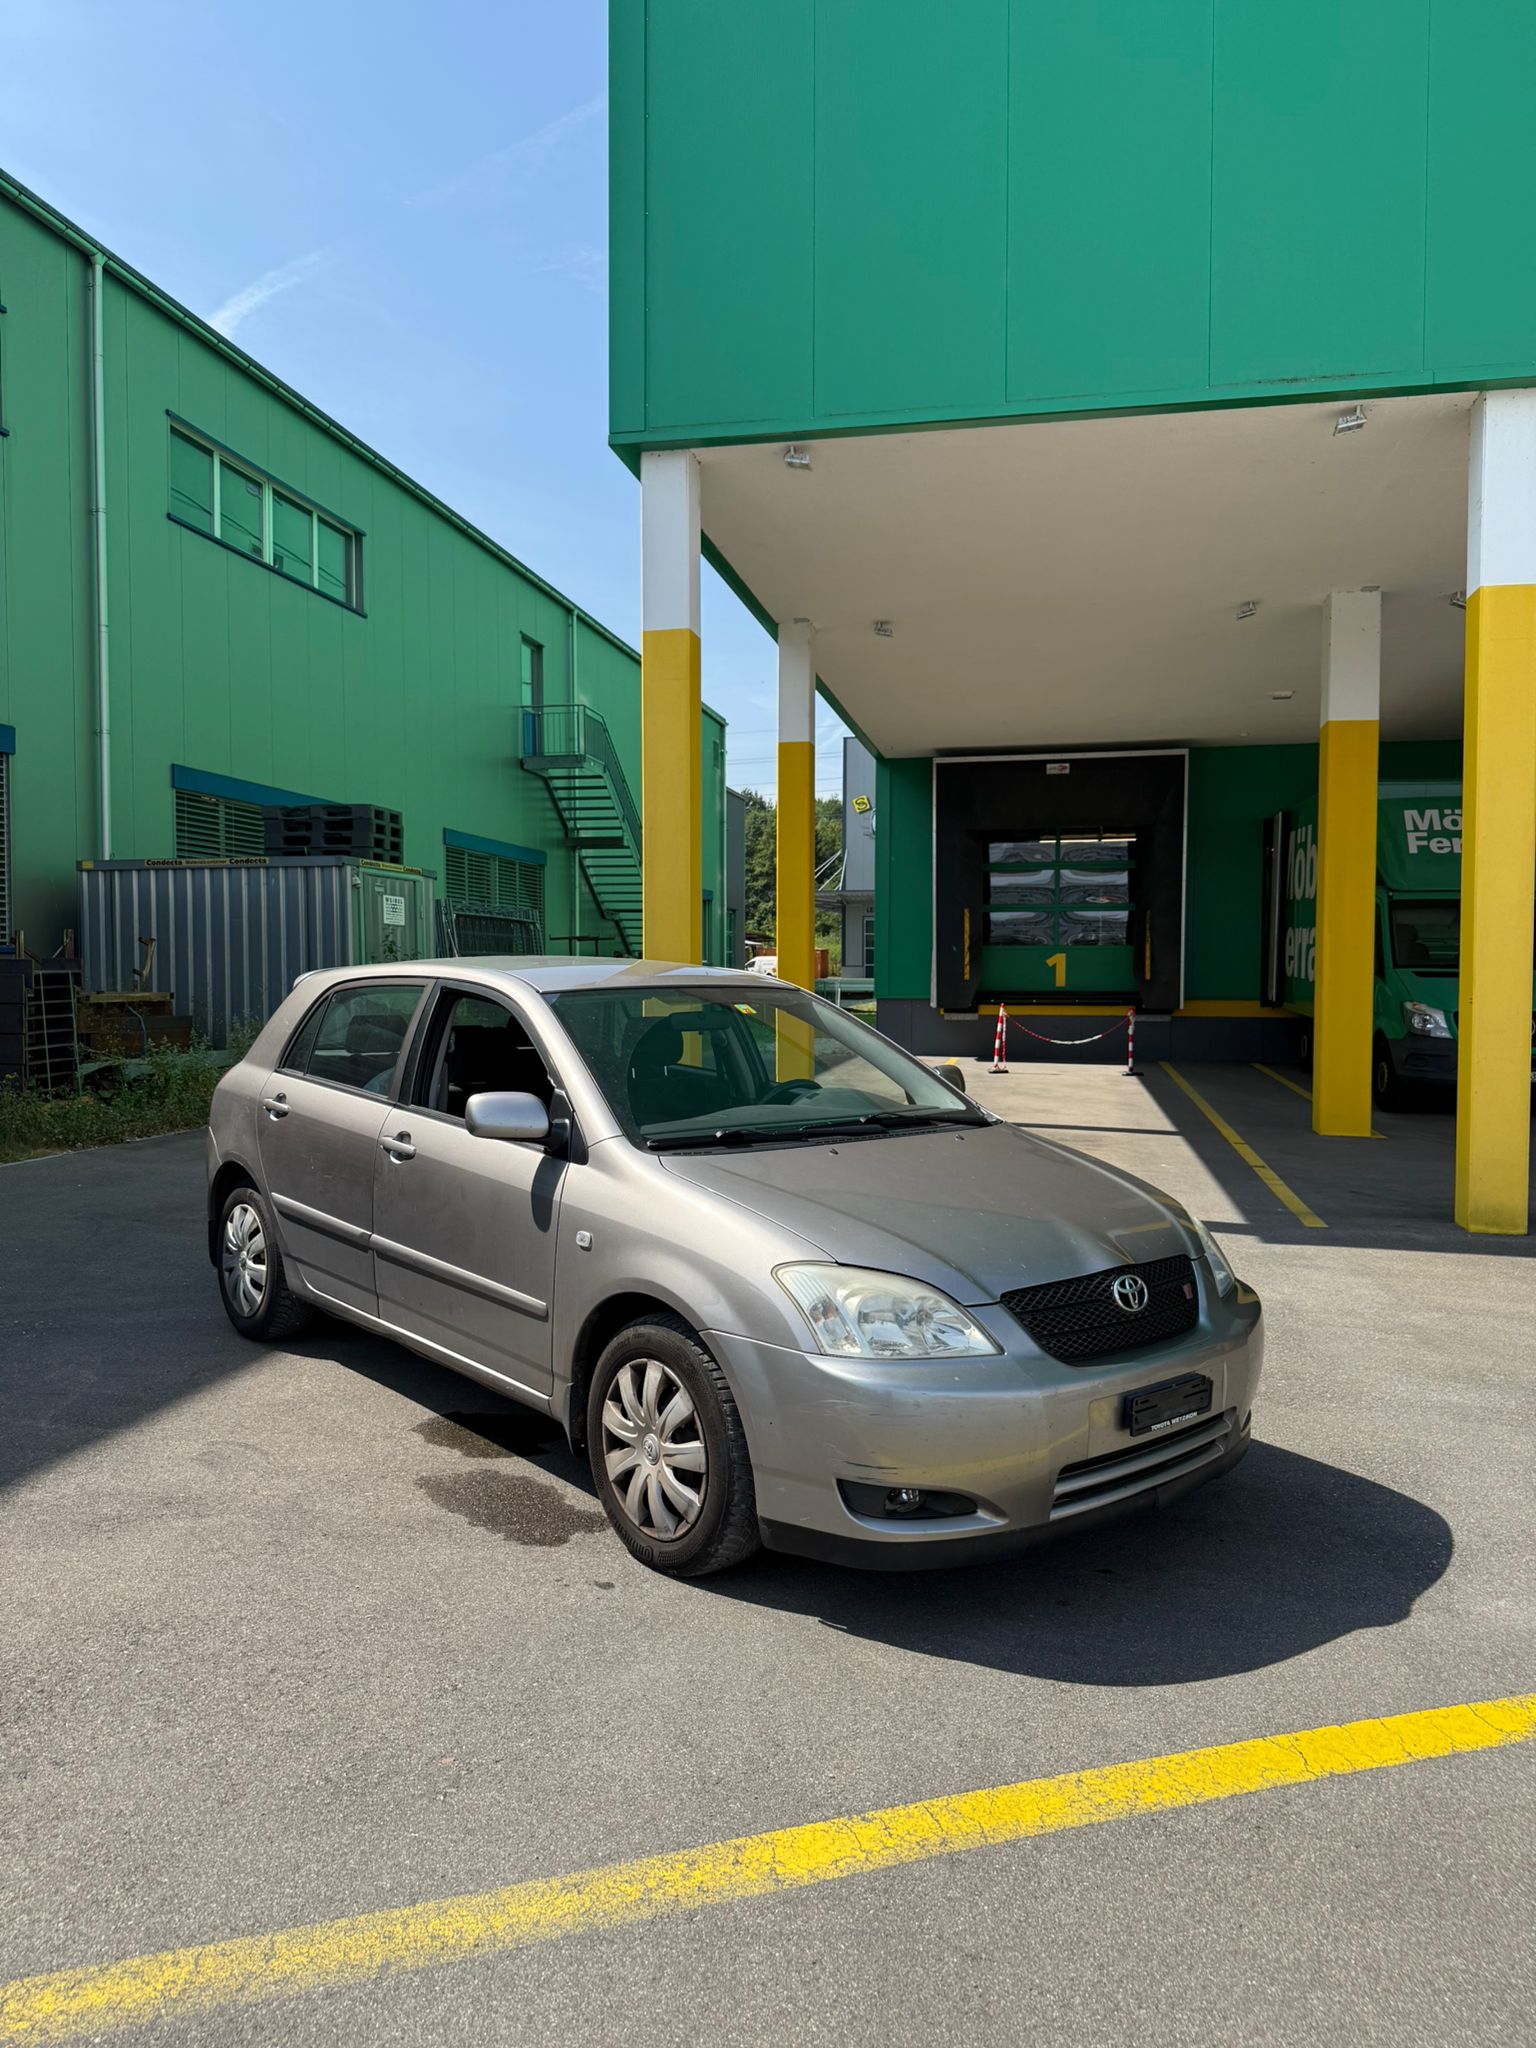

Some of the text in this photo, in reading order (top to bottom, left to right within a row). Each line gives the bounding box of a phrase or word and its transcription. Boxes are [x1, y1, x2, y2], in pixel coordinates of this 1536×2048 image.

[1403, 809, 1462, 831] Mö
[229, 857, 267, 865] Condecta
[1046, 953, 1067, 987] 1
[1151, 1420, 1170, 1431] TOYOTA
